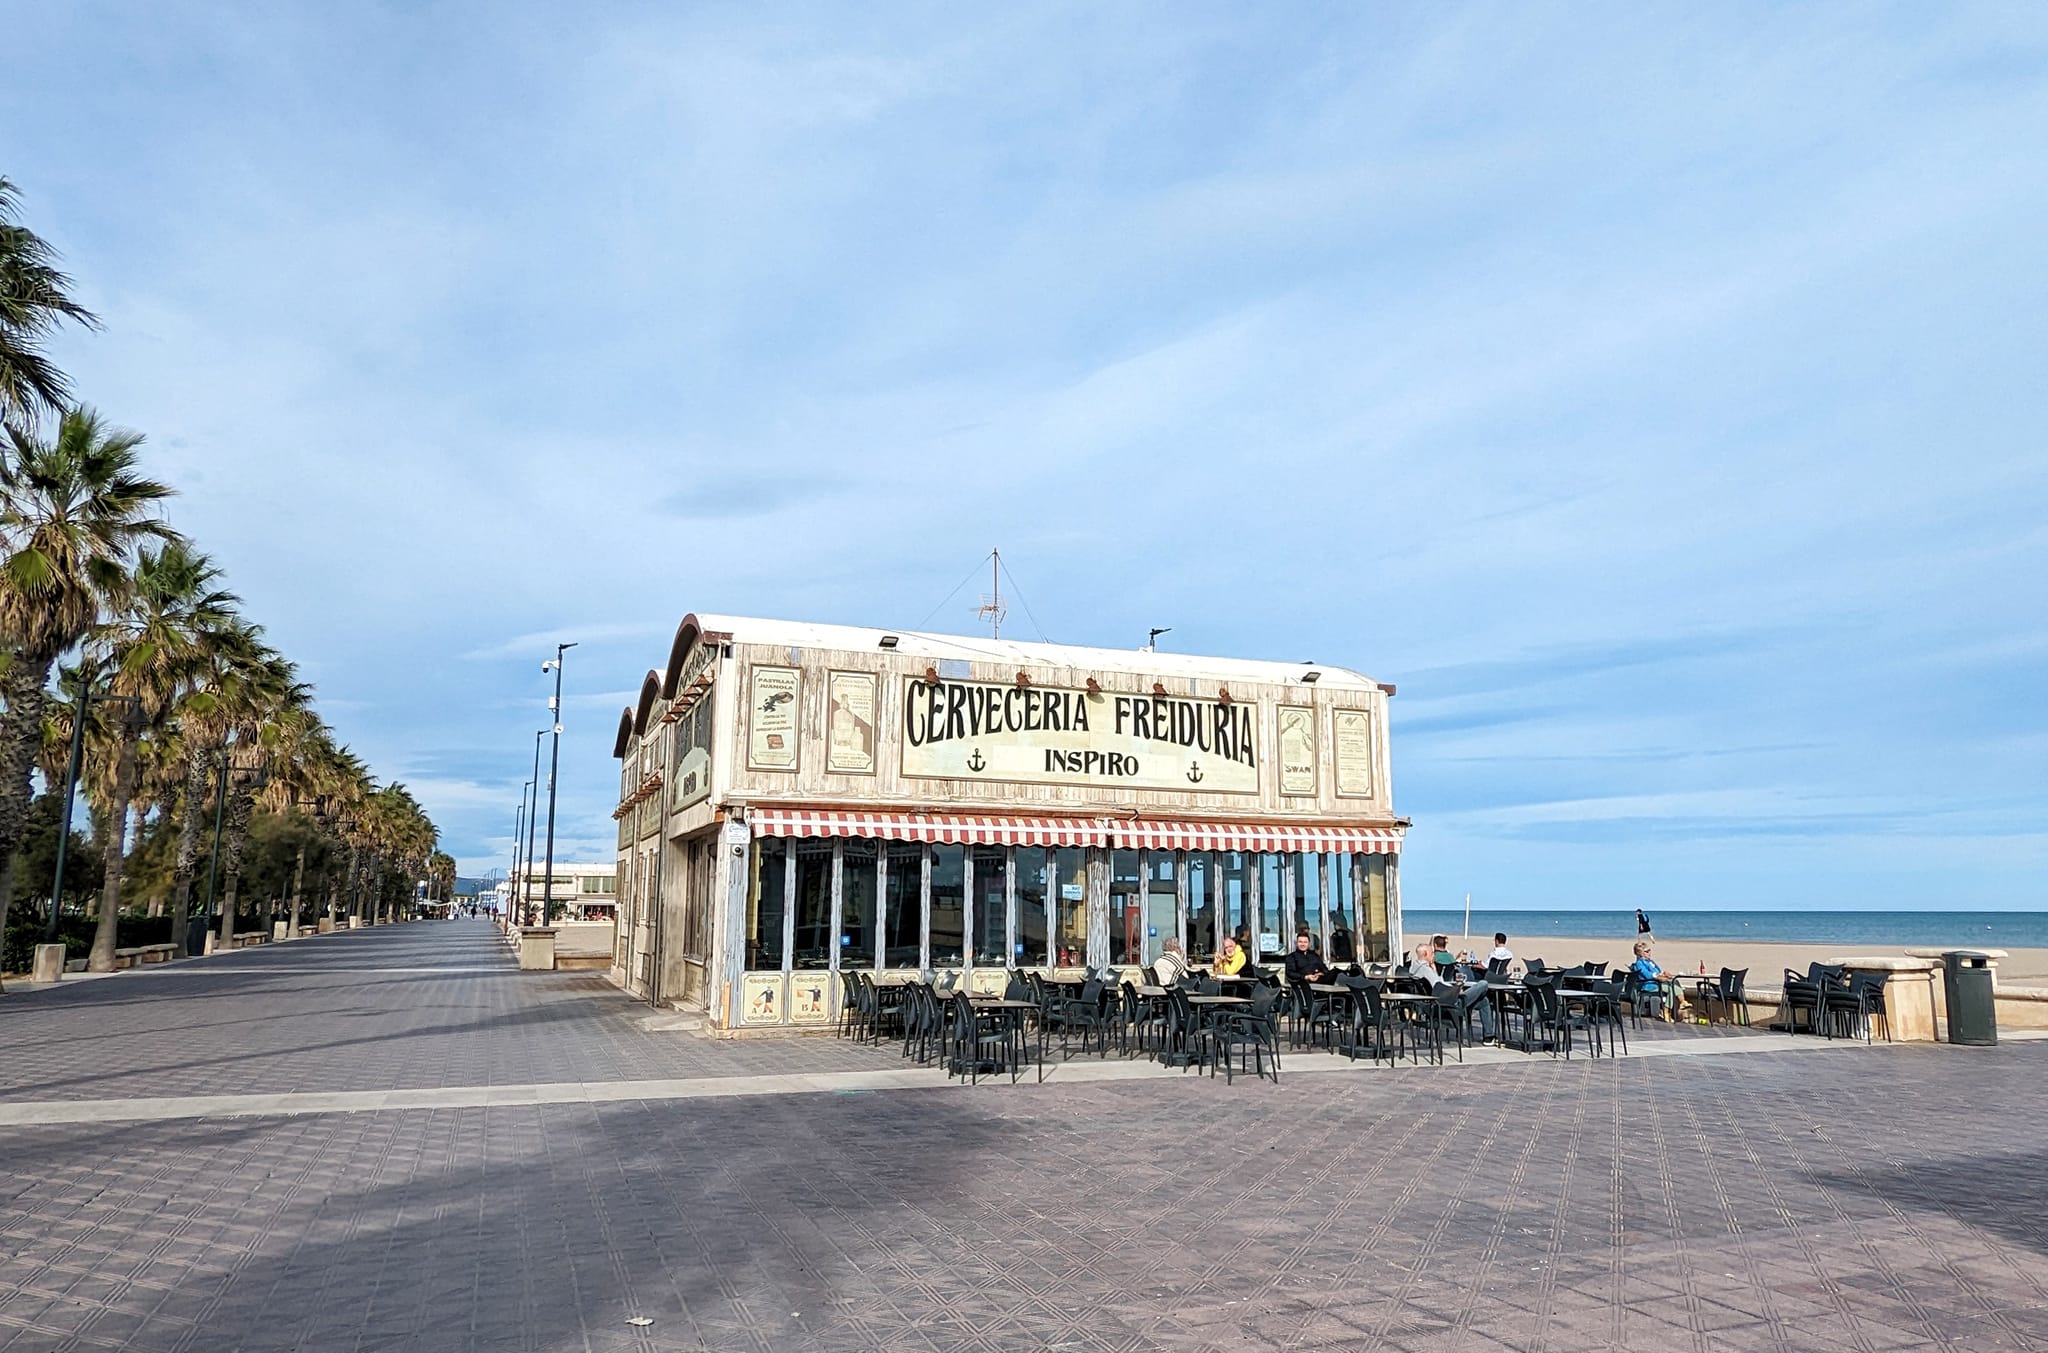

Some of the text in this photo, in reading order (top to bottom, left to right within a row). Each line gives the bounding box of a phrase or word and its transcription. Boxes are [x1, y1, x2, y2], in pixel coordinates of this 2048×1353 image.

[906, 679, 1256, 769] CERVECERIA FREIDURIA
[1044, 748, 1140, 777] INSPIRO
